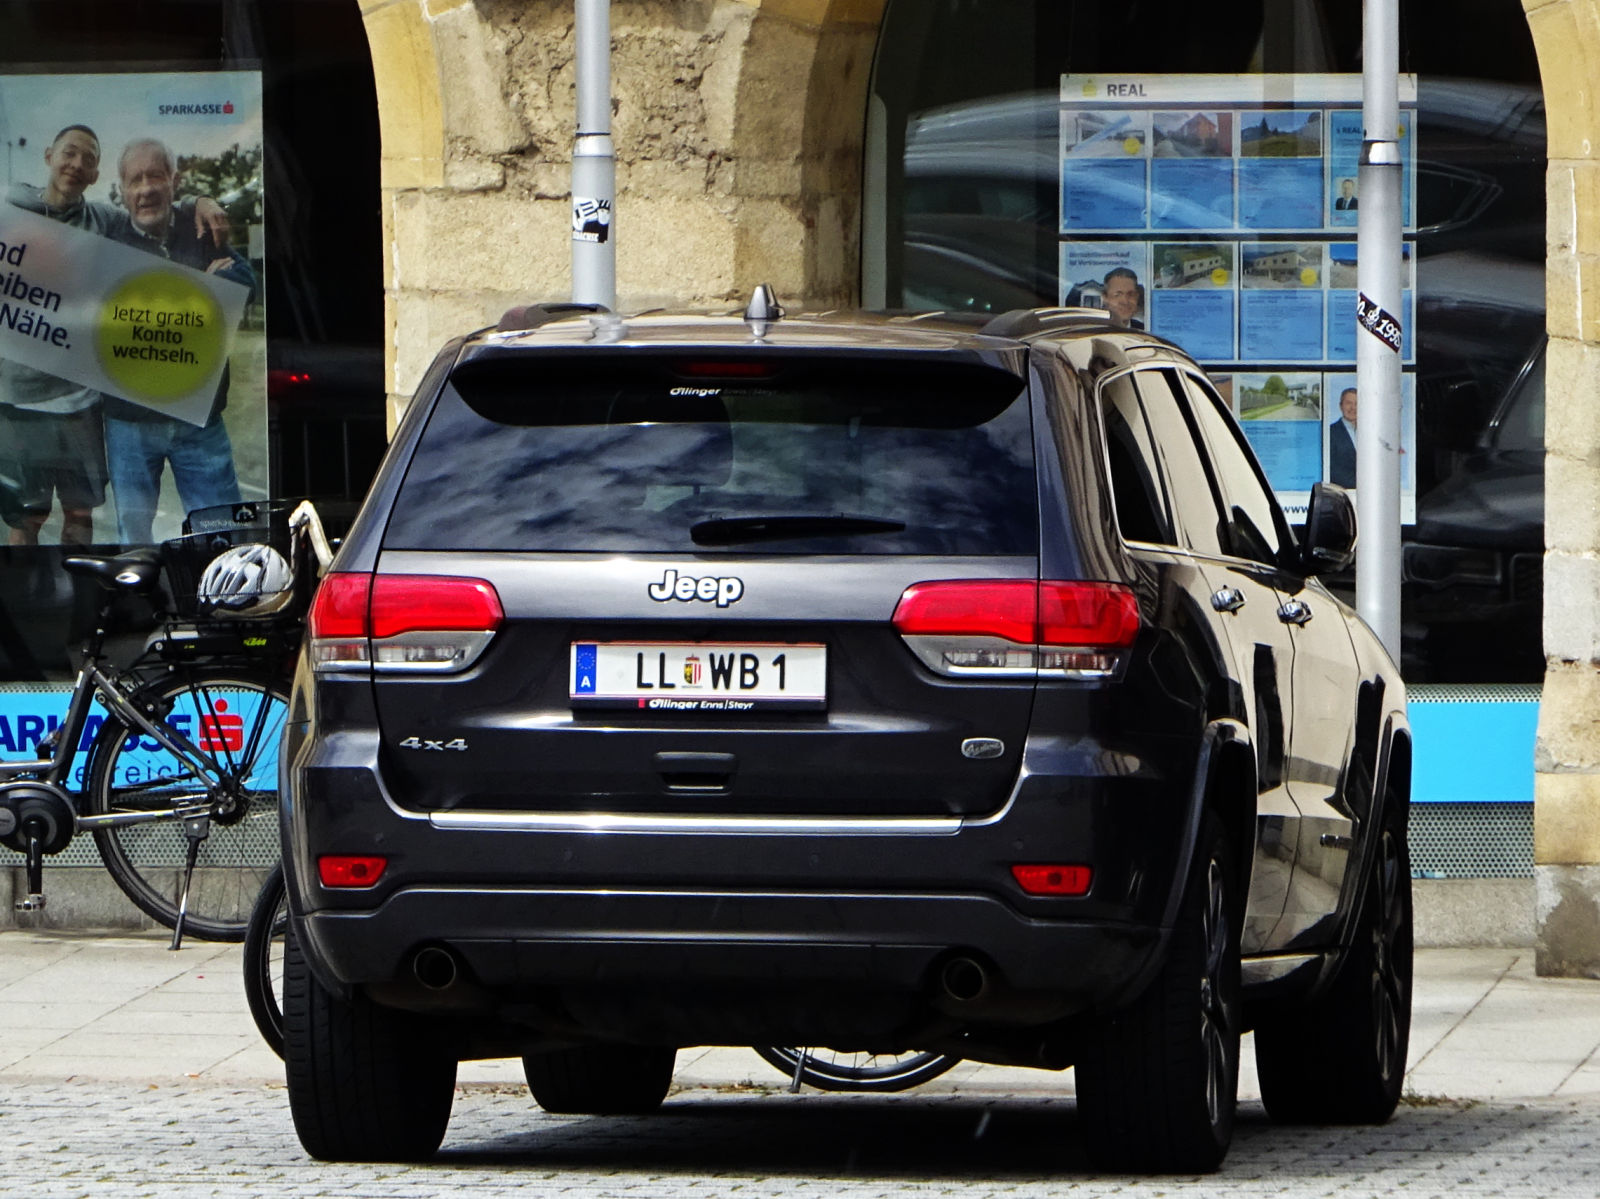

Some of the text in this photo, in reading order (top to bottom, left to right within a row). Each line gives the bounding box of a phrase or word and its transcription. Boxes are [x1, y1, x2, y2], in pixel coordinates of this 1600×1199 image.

[1106, 83, 1148, 98] REAL
[158, 104, 222, 115] SPARKASSE
[0, 303, 72, 350] Nähe.
[112, 305, 204, 328] Jetzt gratis
[132, 325, 183, 344] Konto
[112, 345, 199, 365] wechseln.
[648, 569, 744, 608] Jeep
[581, 675, 591, 688] A
[636, 652, 677, 689] LL
[399, 736, 469, 751] 4x4
